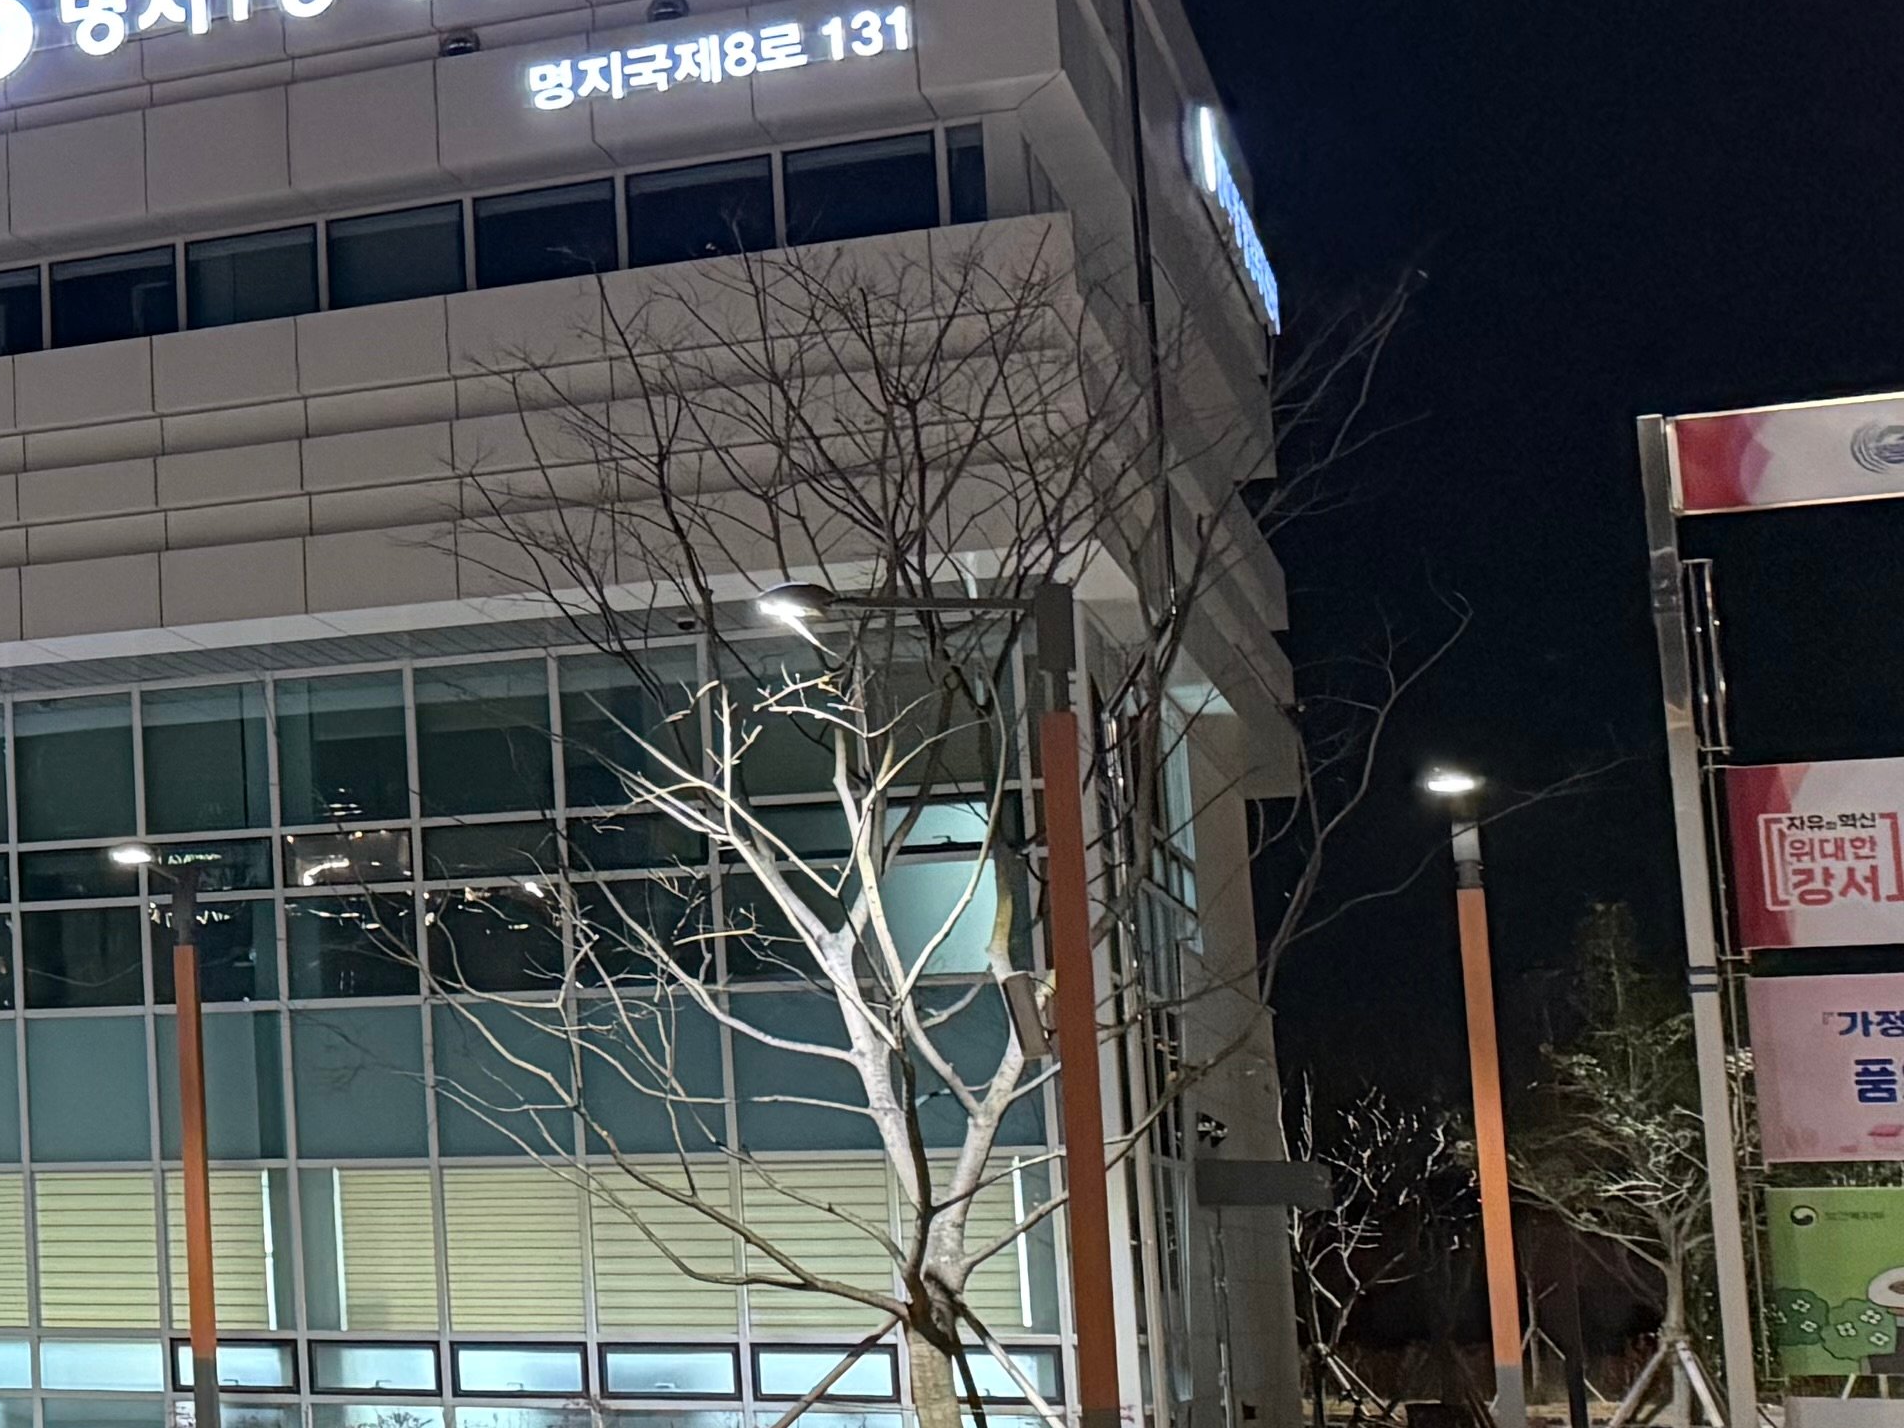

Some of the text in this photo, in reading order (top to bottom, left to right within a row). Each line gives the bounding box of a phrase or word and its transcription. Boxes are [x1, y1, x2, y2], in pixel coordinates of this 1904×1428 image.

[528, 5, 910, 111] 명지국제8로 131
[1838, 812, 1877, 829] 혁신
[1789, 836, 1877, 863] 위대한
[1792, 864, 1881, 906] 강서
